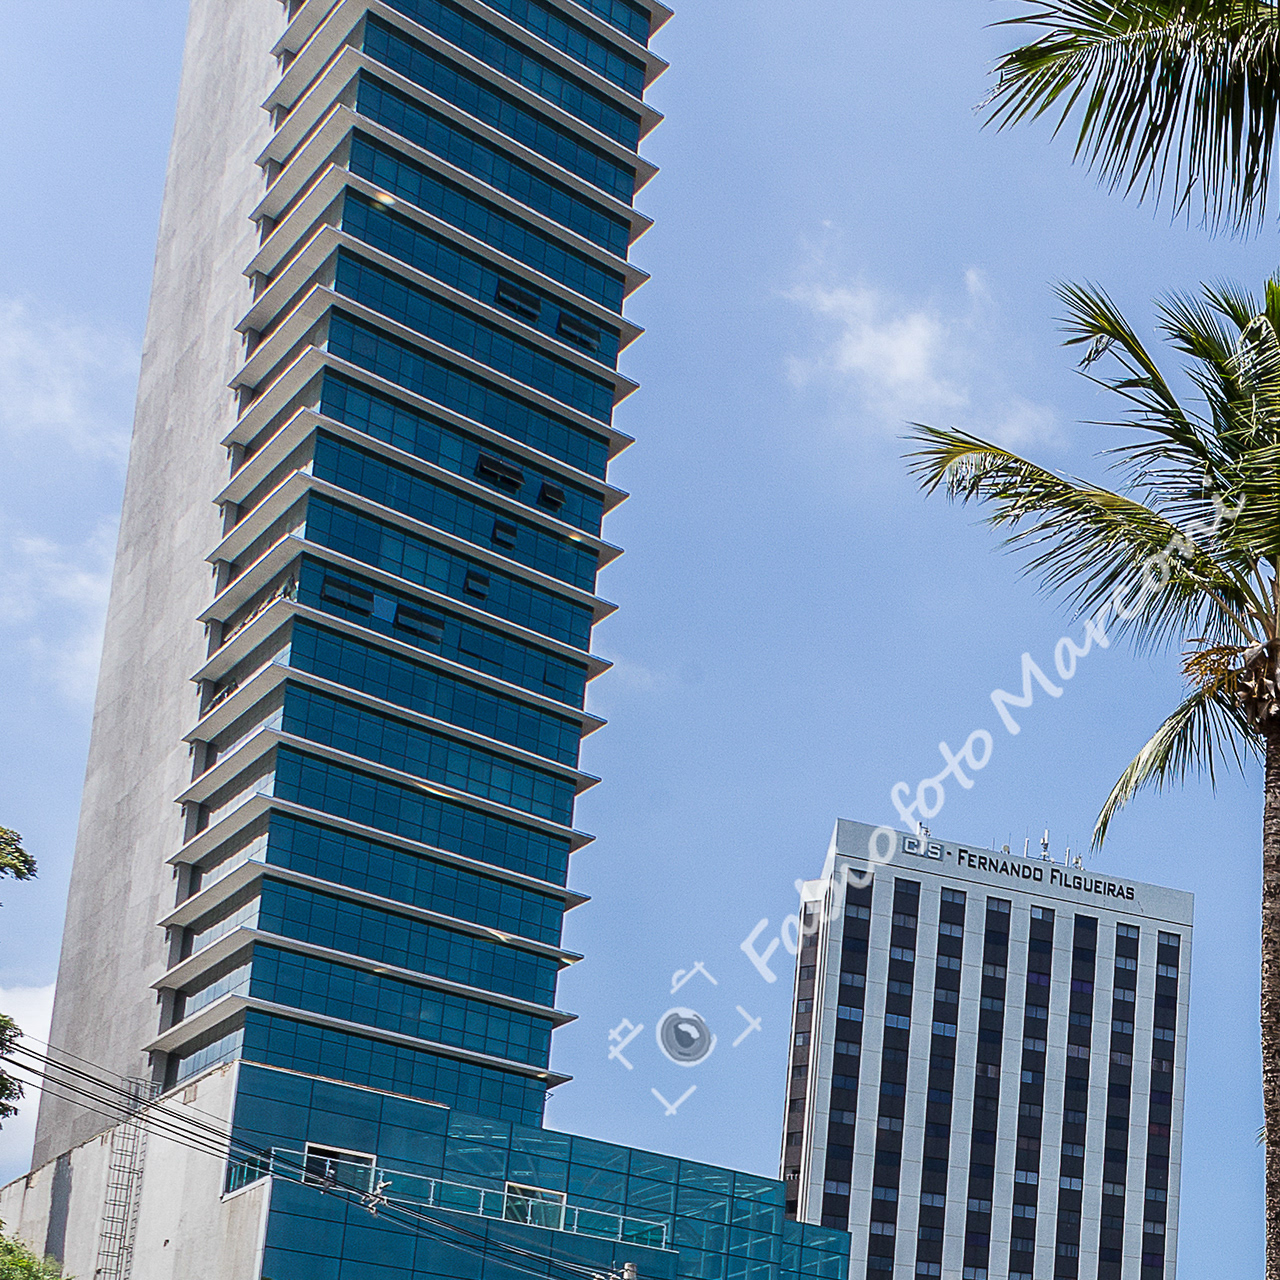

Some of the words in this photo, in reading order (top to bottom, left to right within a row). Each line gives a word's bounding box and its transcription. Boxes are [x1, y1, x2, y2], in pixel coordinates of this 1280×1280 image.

[903, 837, 942, 860] CIS
[957, 848, 1043, 882] FERNANDO
[1049, 868, 1135, 901] FILGUEIRAS
